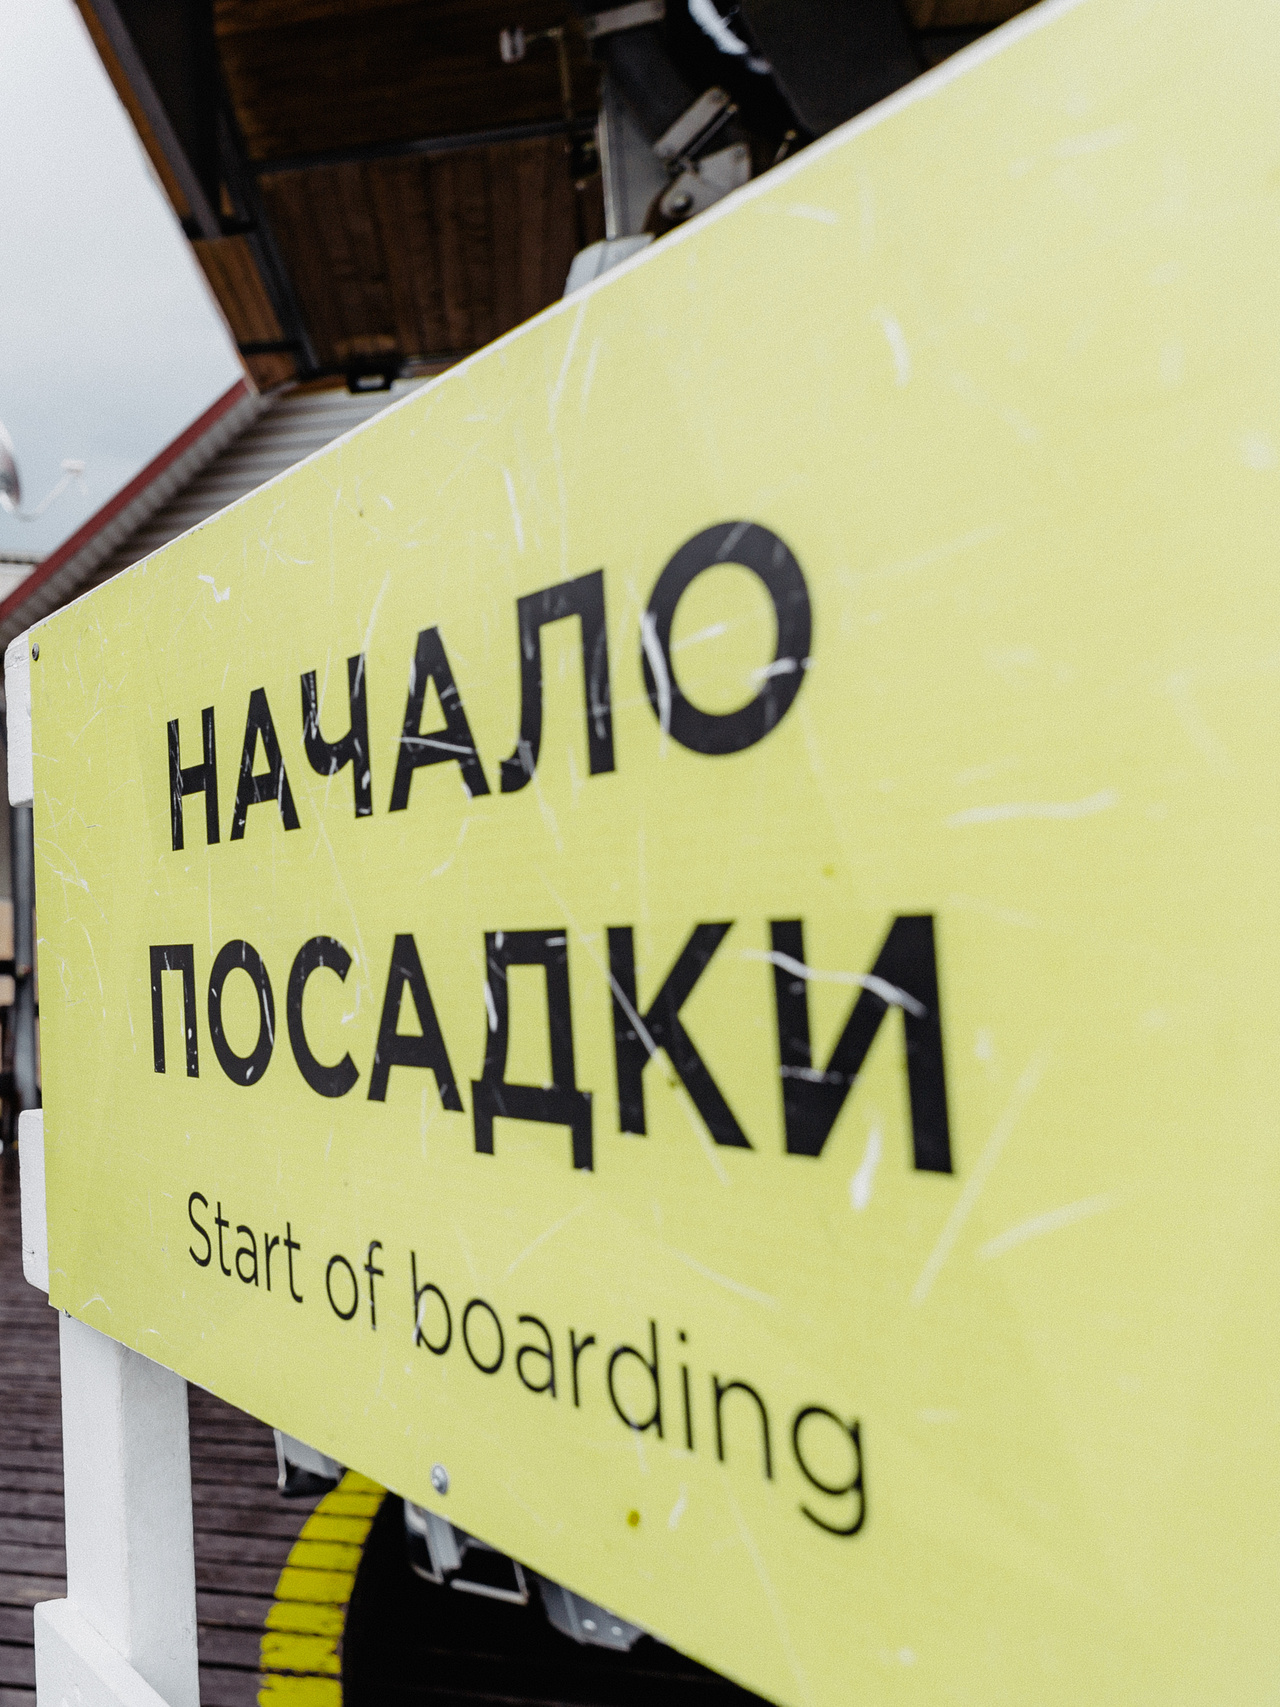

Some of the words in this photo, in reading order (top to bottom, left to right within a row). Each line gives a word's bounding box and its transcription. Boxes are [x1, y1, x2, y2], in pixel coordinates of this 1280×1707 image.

[166, 521, 813, 852] НАЧАЛО
[149, 913, 955, 1176] ПОСАДКИ
[187, 1190, 304, 1304] Start
[324, 1239, 385, 1331] of
[410, 1250, 869, 1538] boarding
